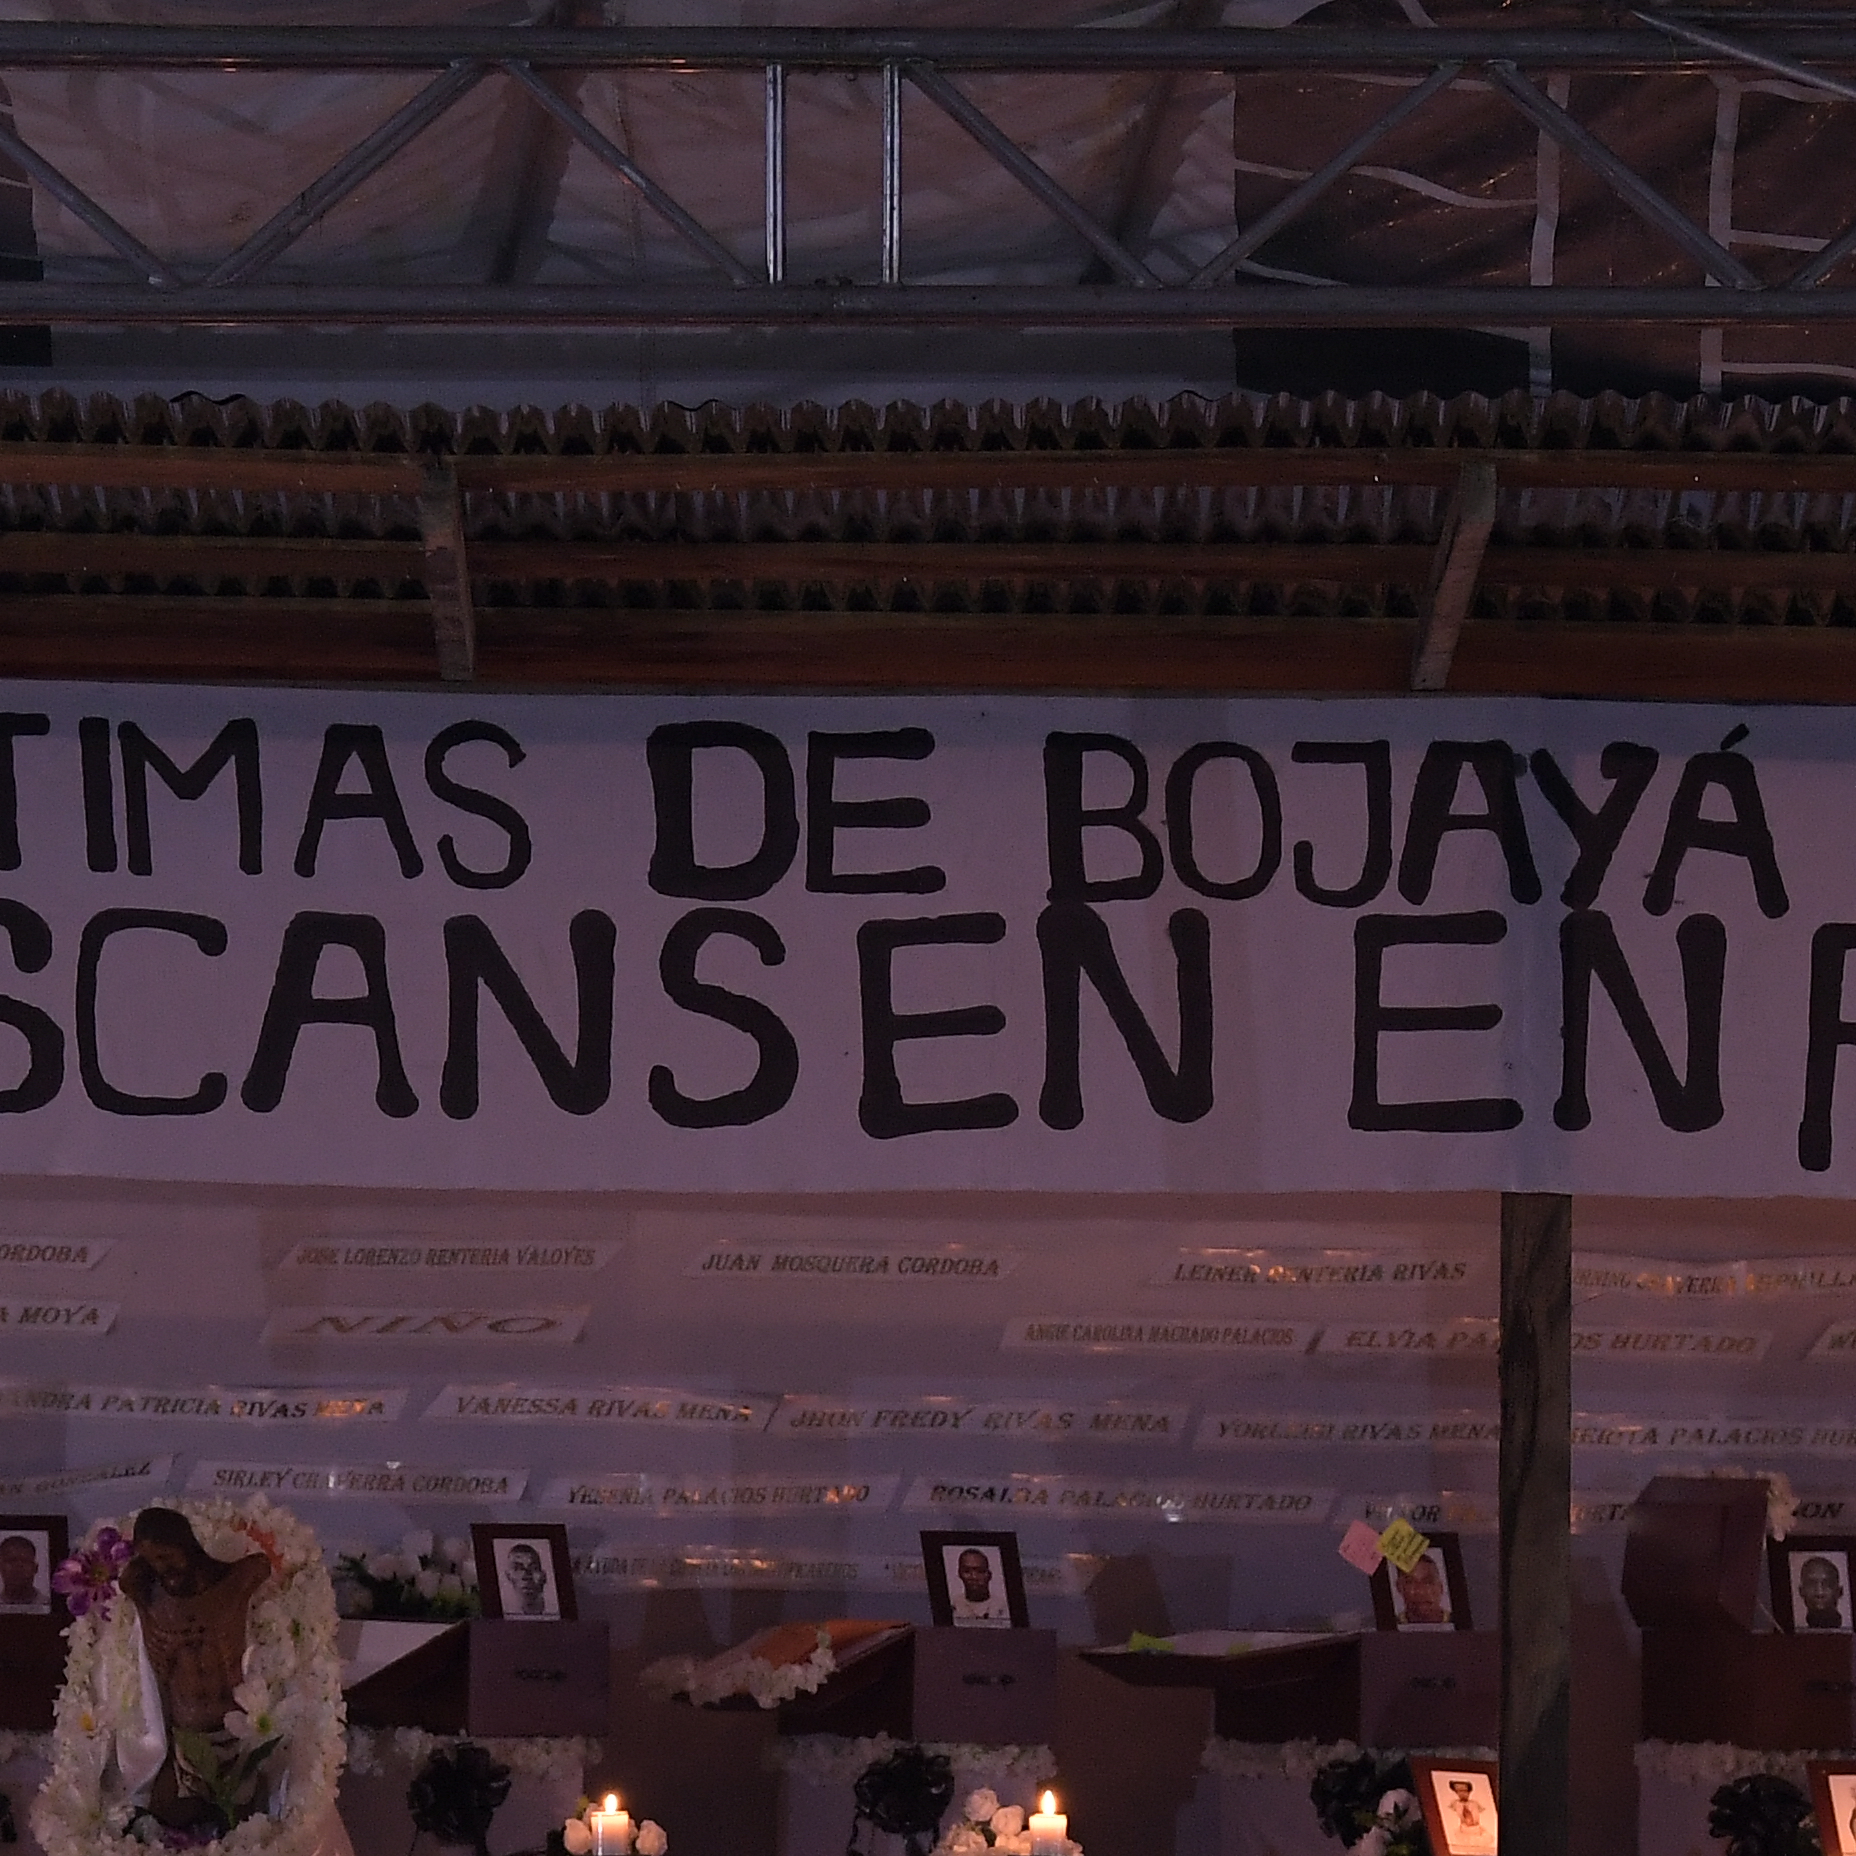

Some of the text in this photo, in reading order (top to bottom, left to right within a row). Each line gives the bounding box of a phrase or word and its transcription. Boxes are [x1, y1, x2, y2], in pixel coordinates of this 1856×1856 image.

[645, 719, 946, 901] DE
[1038, 722, 1790, 919] BOJAYÁ
[1348, 908, 1728, 1133] EN
[297, 1245, 596, 1266] JOSE LORENZO RENTERIA VALOYES
[702, 1254, 1000, 1276] JUAN MOSQUERA CORDOBA
[1175, 1262, 1261, 1283] LEINER
[1393, 1261, 1467, 1281] RIVAS
[18, 1305, 101, 1326] MOYA
[1073, 1323, 1145, 1343] CAROLINA
[1223, 1326, 1294, 1345] PALACIOS
[1346, 1328, 1436, 1349] ELVIA
[1609, 1332, 1760, 1353] HURTADO
[101, 1395, 222, 1416] PATRICIA
[230, 1398, 307, 1419] RIVAS
[456, 1396, 753, 1422] VANESSA RIVAS MENA
[872, 1408, 975, 1429] FREDY
[983, 1411, 1075, 1431] RIVAS
[1089, 1412, 1170, 1432] MENA
[1344, 1422, 1422, 1441] RIVAS
[1429, 1421, 1501, 1441] MENA
[1670, 1427, 1804, 1446] PALACIOS
[212, 1467, 294, 1488] SIRLEY
[411, 1474, 508, 1495] CORDOBA
[662, 1486, 766, 1506] PALACIOS
[929, 1484, 1048, 1504] ROSALBA
[1192, 1491, 1313, 1511] HURTADO
